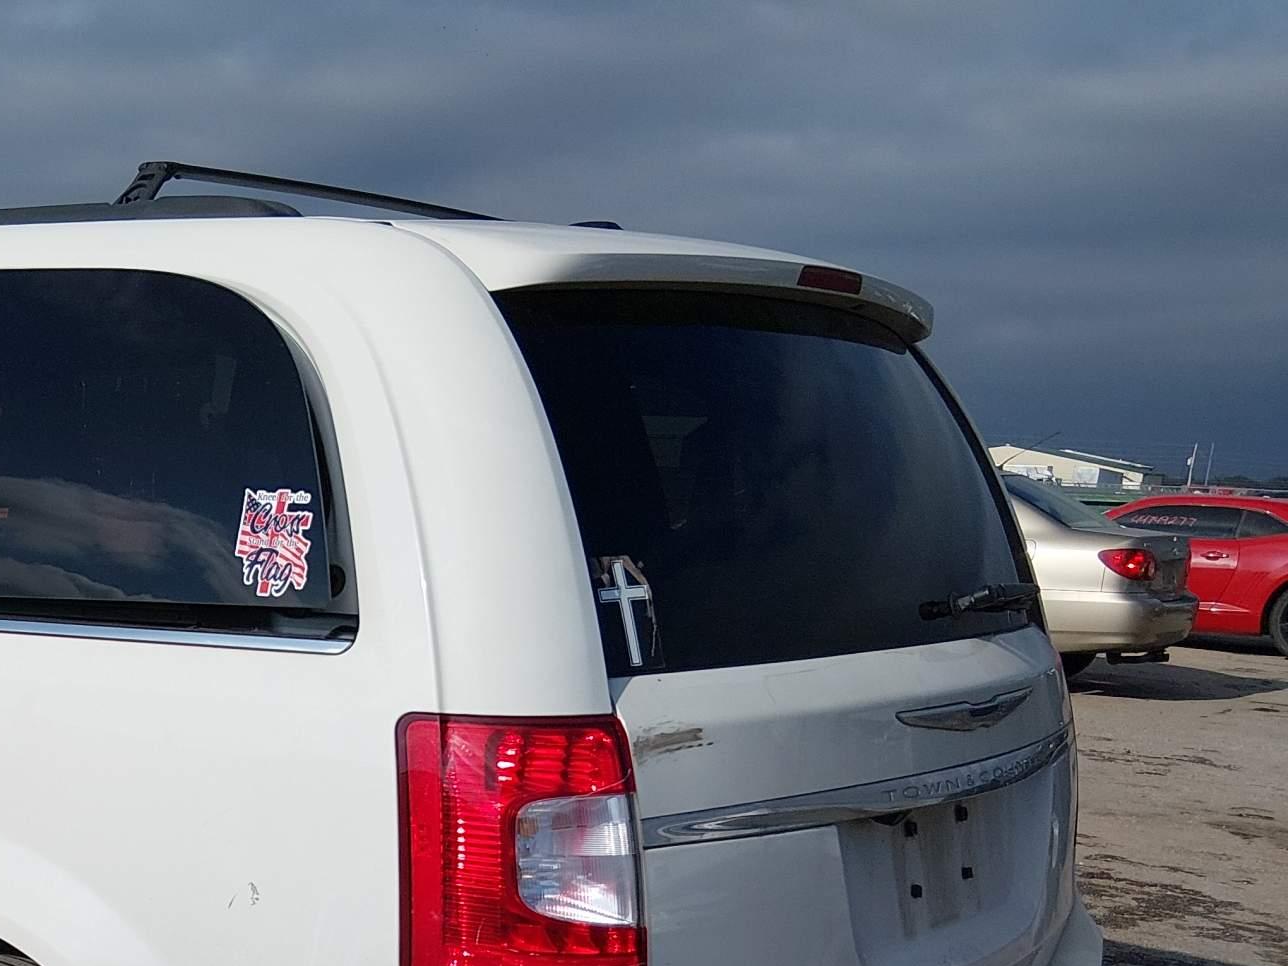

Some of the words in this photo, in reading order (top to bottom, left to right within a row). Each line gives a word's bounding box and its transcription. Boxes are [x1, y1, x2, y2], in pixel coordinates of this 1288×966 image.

[296, 493, 309, 502] the
[250, 503, 306, 537] Cross
[246, 547, 292, 592] Flag
[881, 778, 961, 801] TOWN
